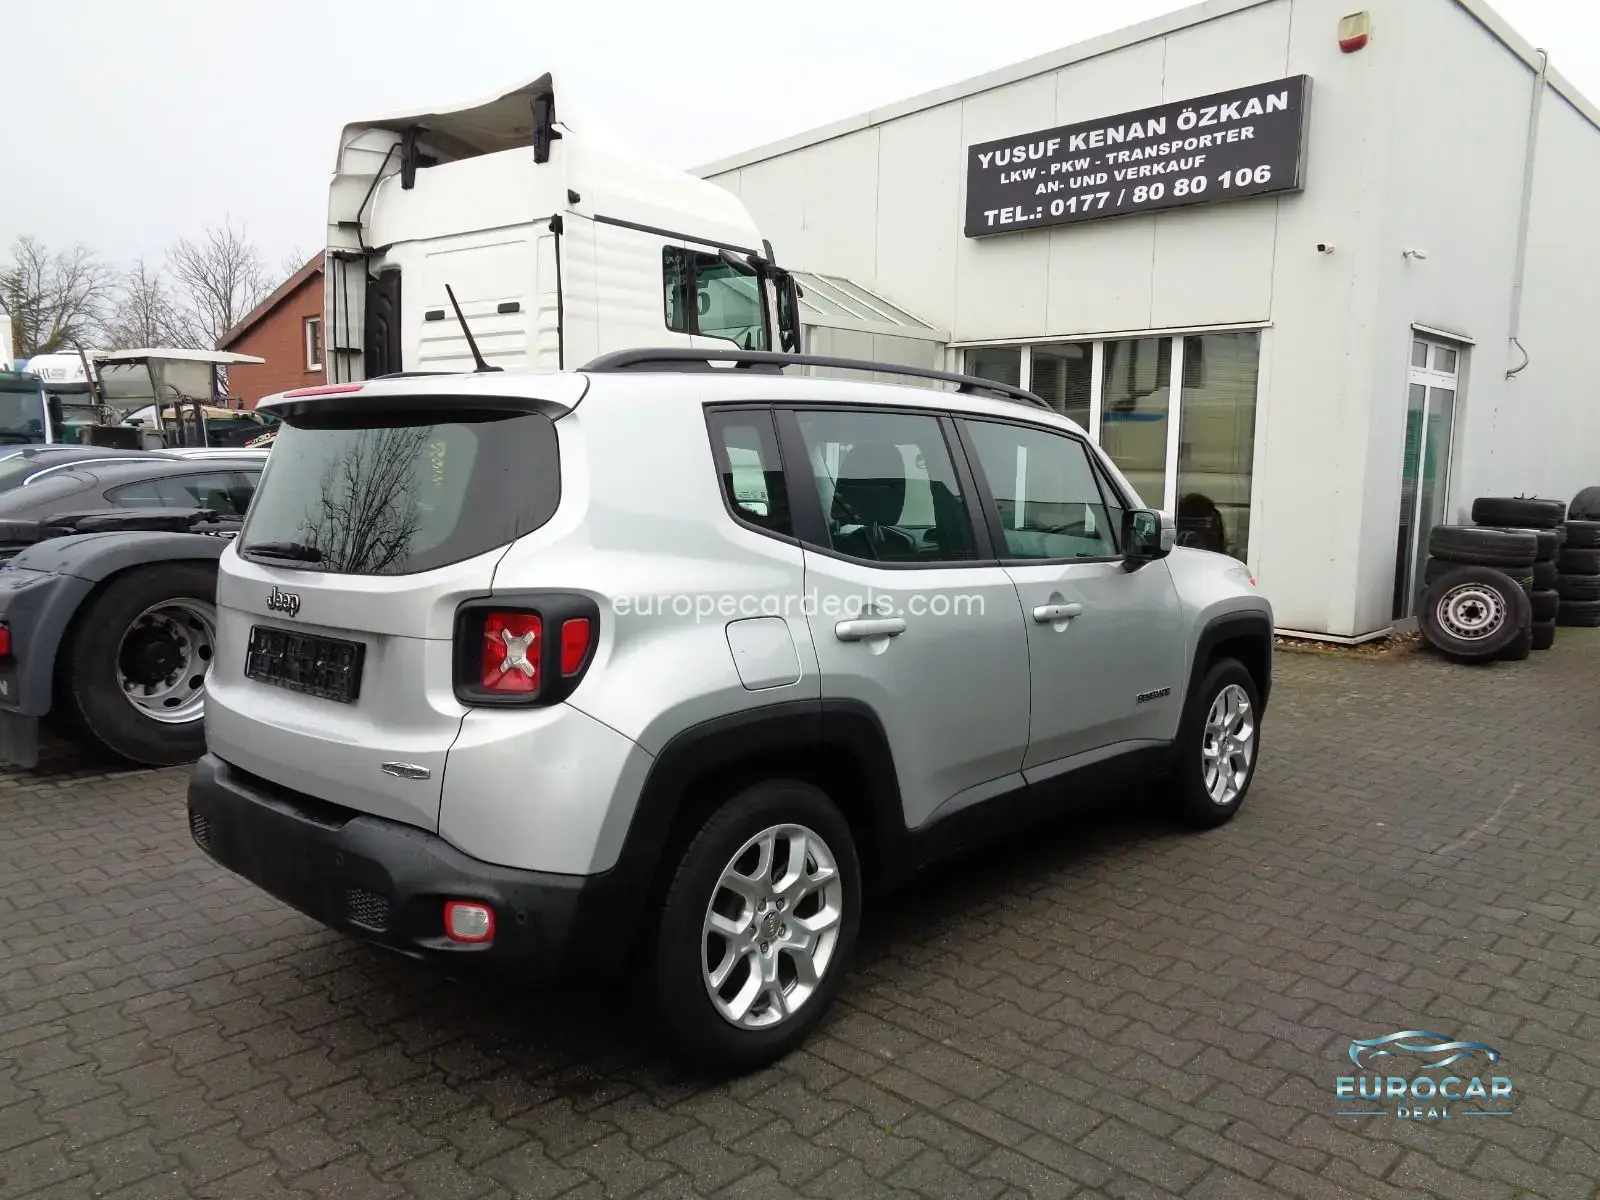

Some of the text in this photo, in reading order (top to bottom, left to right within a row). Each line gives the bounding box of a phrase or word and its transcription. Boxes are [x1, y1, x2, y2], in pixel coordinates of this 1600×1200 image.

[977, 91, 1289, 169] YUSUF KENAN ÖZKAN
[1000, 166, 1036, 184] LKW
[1050, 157, 1090, 175] PKW
[1106, 126, 1254, 166] TRANSPORTER
[984, 164, 1272, 226] TEL.: 0177 / 80 80 106
[1035, 155, 1206, 195] AN- UND VERKAUF
[267, 586, 300, 617] Jeep
